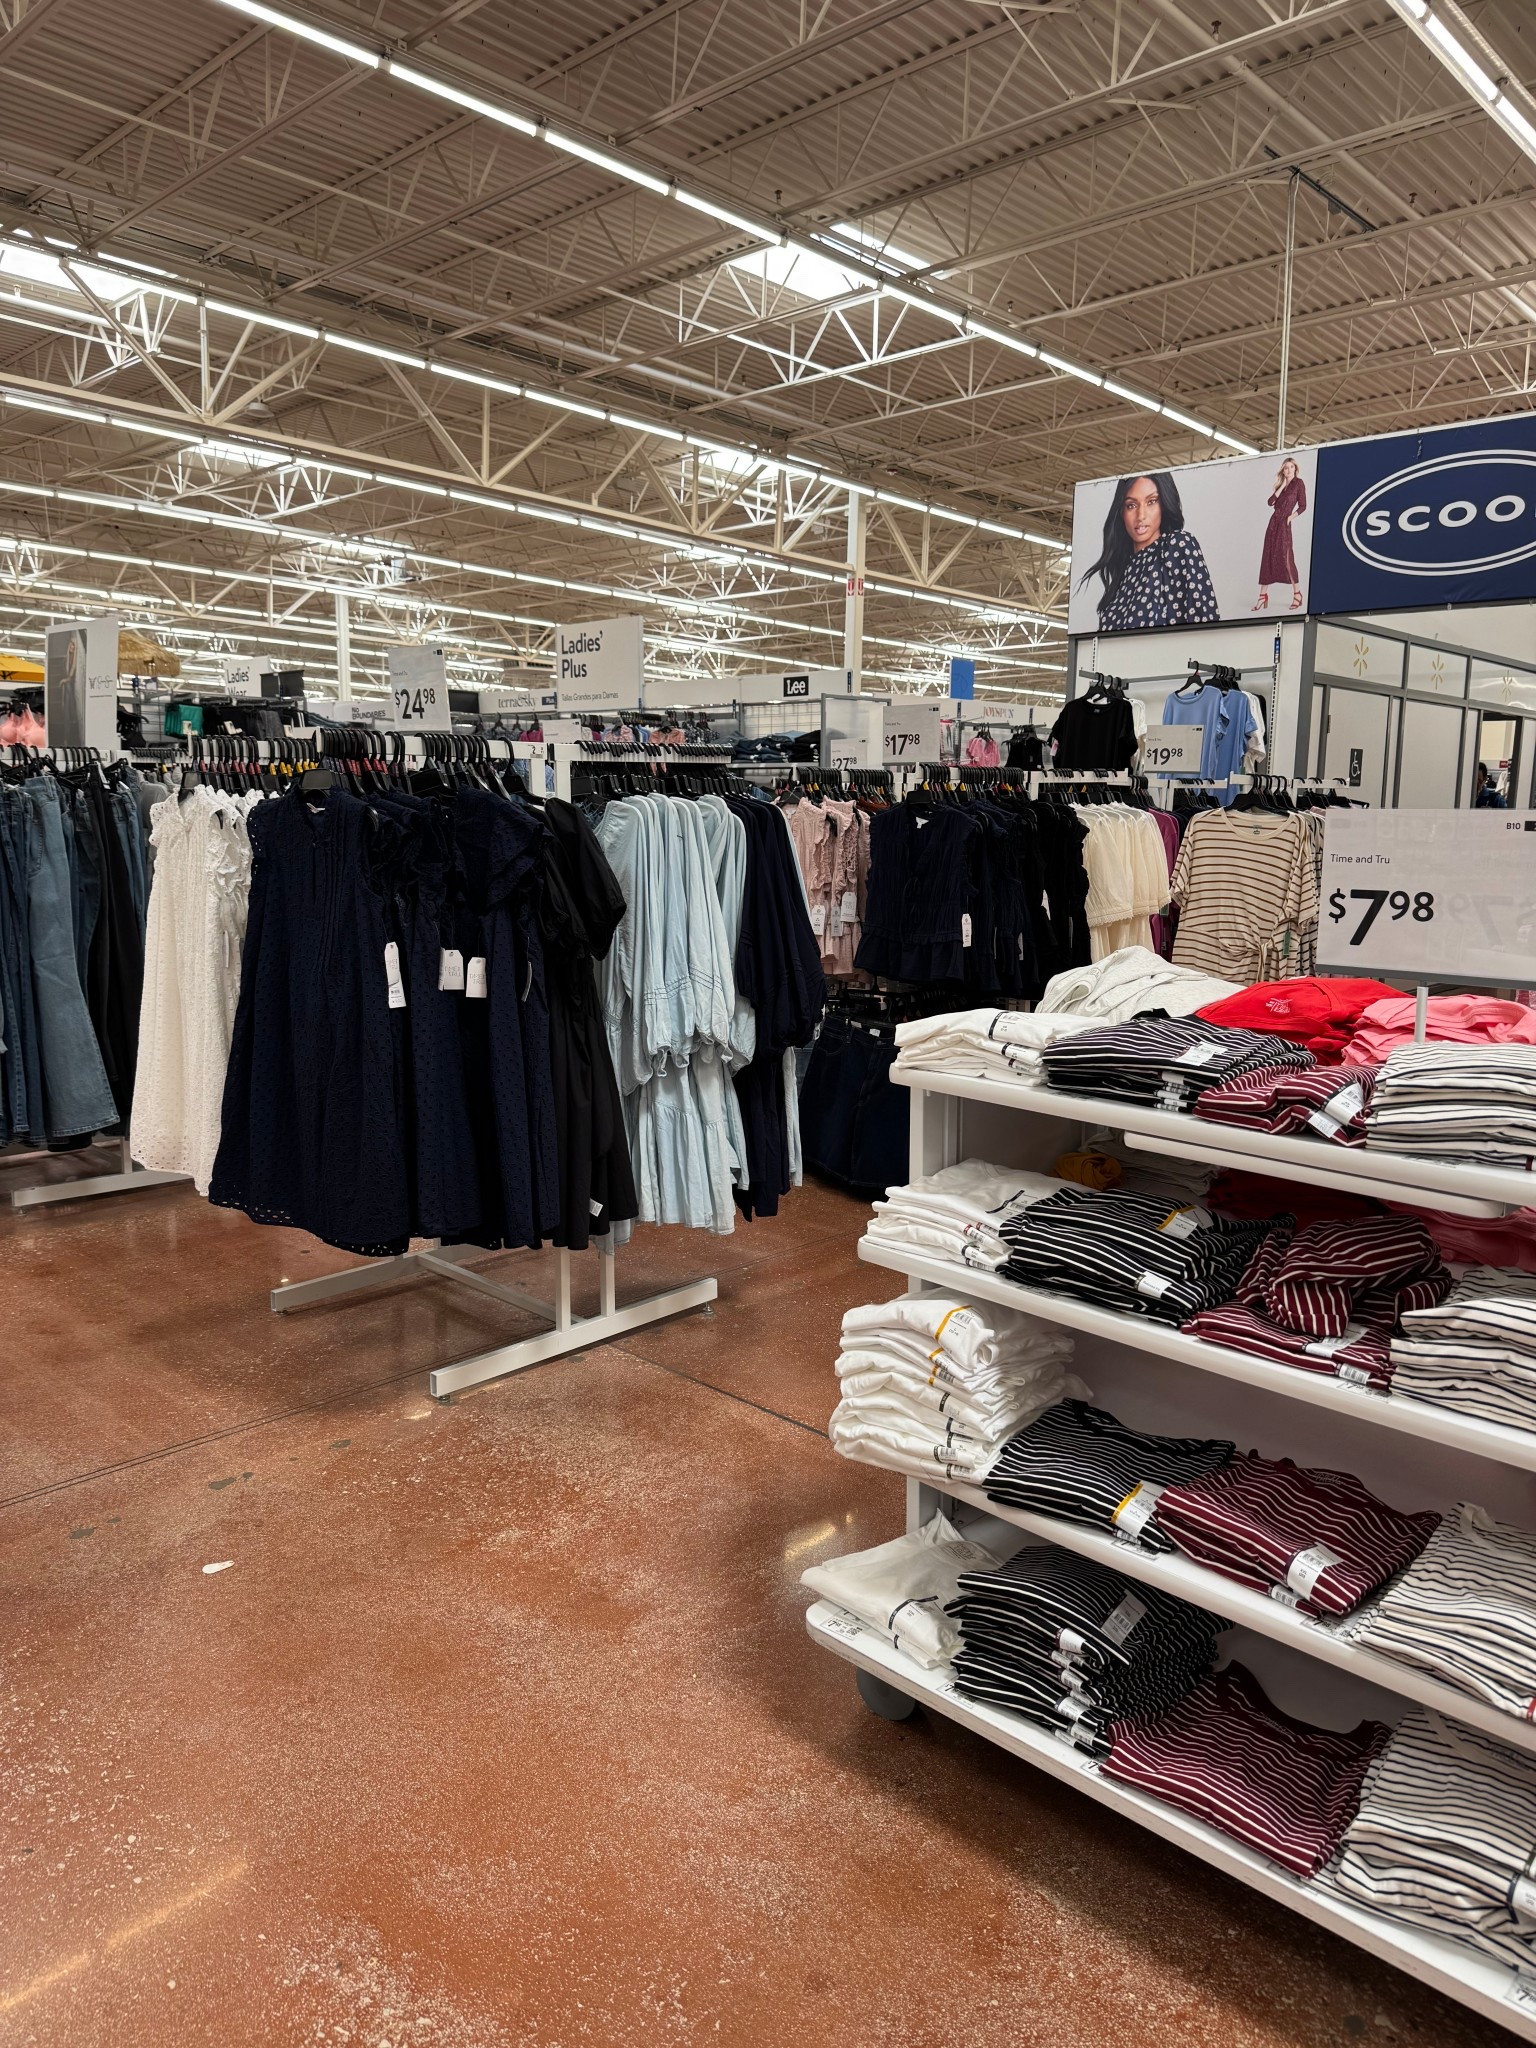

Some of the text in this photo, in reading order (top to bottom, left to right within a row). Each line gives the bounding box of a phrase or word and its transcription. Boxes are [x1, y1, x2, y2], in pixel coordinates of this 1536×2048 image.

[1366, 494, 1536, 536] SCOO
[561, 630, 603, 655] Ladies'
[561, 658, 588, 679] Plus
[786, 679, 806, 694] Lee
[573, 693, 592, 701] Grandes
[592, 693, 602, 702] para
[602, 691, 619, 699] Damas
[352, 710, 386, 720] BOUNDARIES
[983, 706, 1015, 719] JOYSPUN
[1506, 822, 1521, 830] B10
[1330, 854, 1390, 864] Time and Tru
